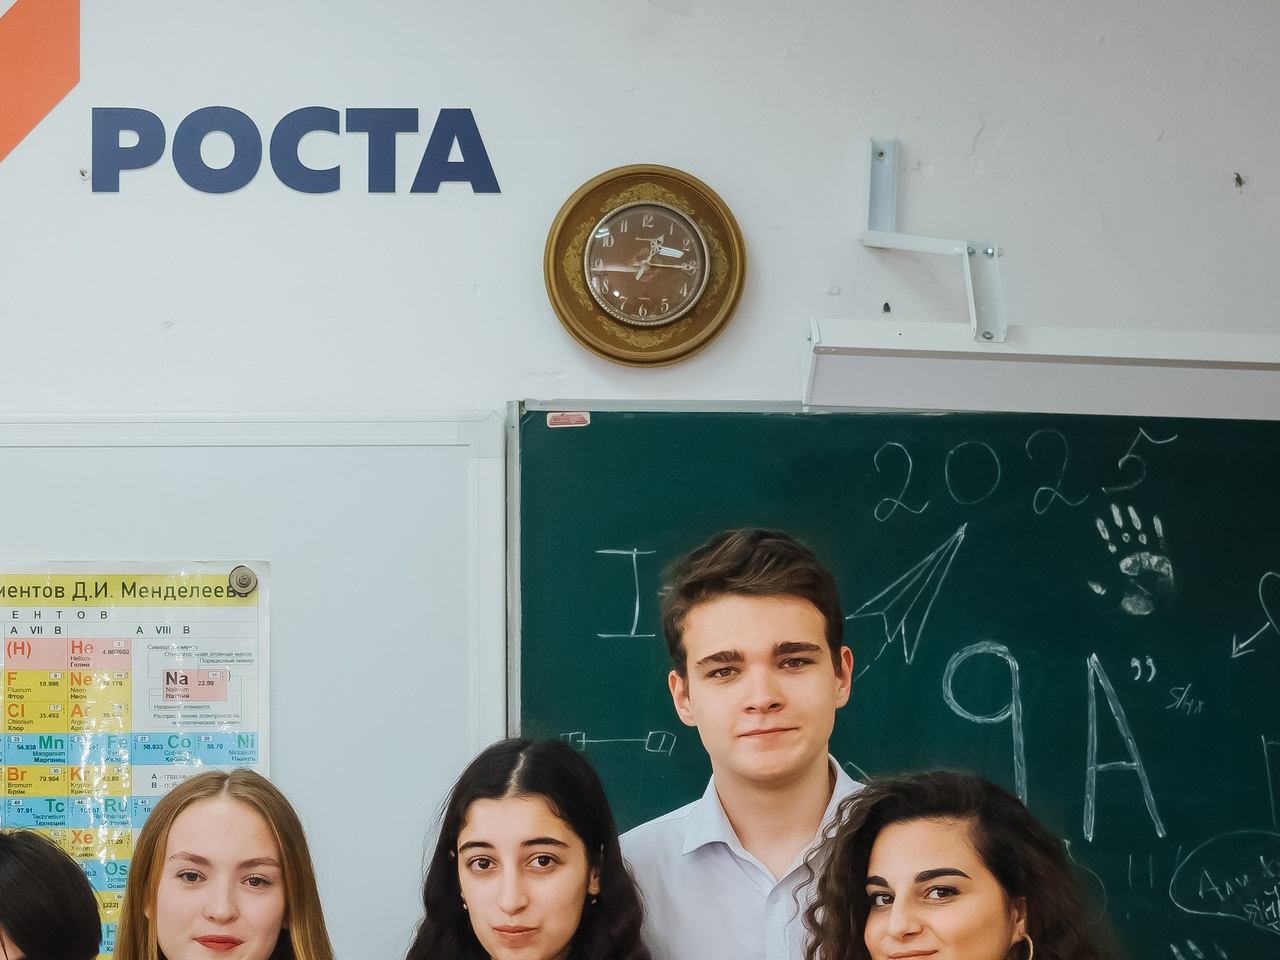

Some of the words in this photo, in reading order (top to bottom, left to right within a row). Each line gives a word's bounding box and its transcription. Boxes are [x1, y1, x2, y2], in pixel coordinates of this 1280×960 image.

[91, 105, 502, 195] РОСТА
[620, 220, 628, 233] 11
[642, 213, 653, 228] 12
[669, 222, 674, 235] 1
[602, 234, 615, 248] 10
[682, 238, 690, 251] 2
[595, 258, 603, 269] 9
[602, 279, 609, 294] 8
[679, 283, 688, 297] 4
[619, 296, 628, 311] 7
[639, 304, 647, 317] 6
[660, 298, 669, 313] 5
[874, 427, 1178, 523] 2025
[71, 581, 114, 602] Д.И.
[30, 626, 43, 635] VII
[155, 626, 171, 635] VIII
[6, 640, 32, 659] (H)
[71, 640, 94, 655] He
[7, 672, 18, 686] F
[70, 671, 93, 686] Ne
[166, 671, 189, 686] Na
[7, 703, 25, 718] Cl
[38, 735, 64, 750] Mn
[167, 734, 192, 749] Co
[237, 734, 255, 749] Ni
[7, 766, 28, 781] Br
[44, 798, 65, 813] Tc
[71, 829, 94, 845] Xe
[104, 861, 128, 876] Os
